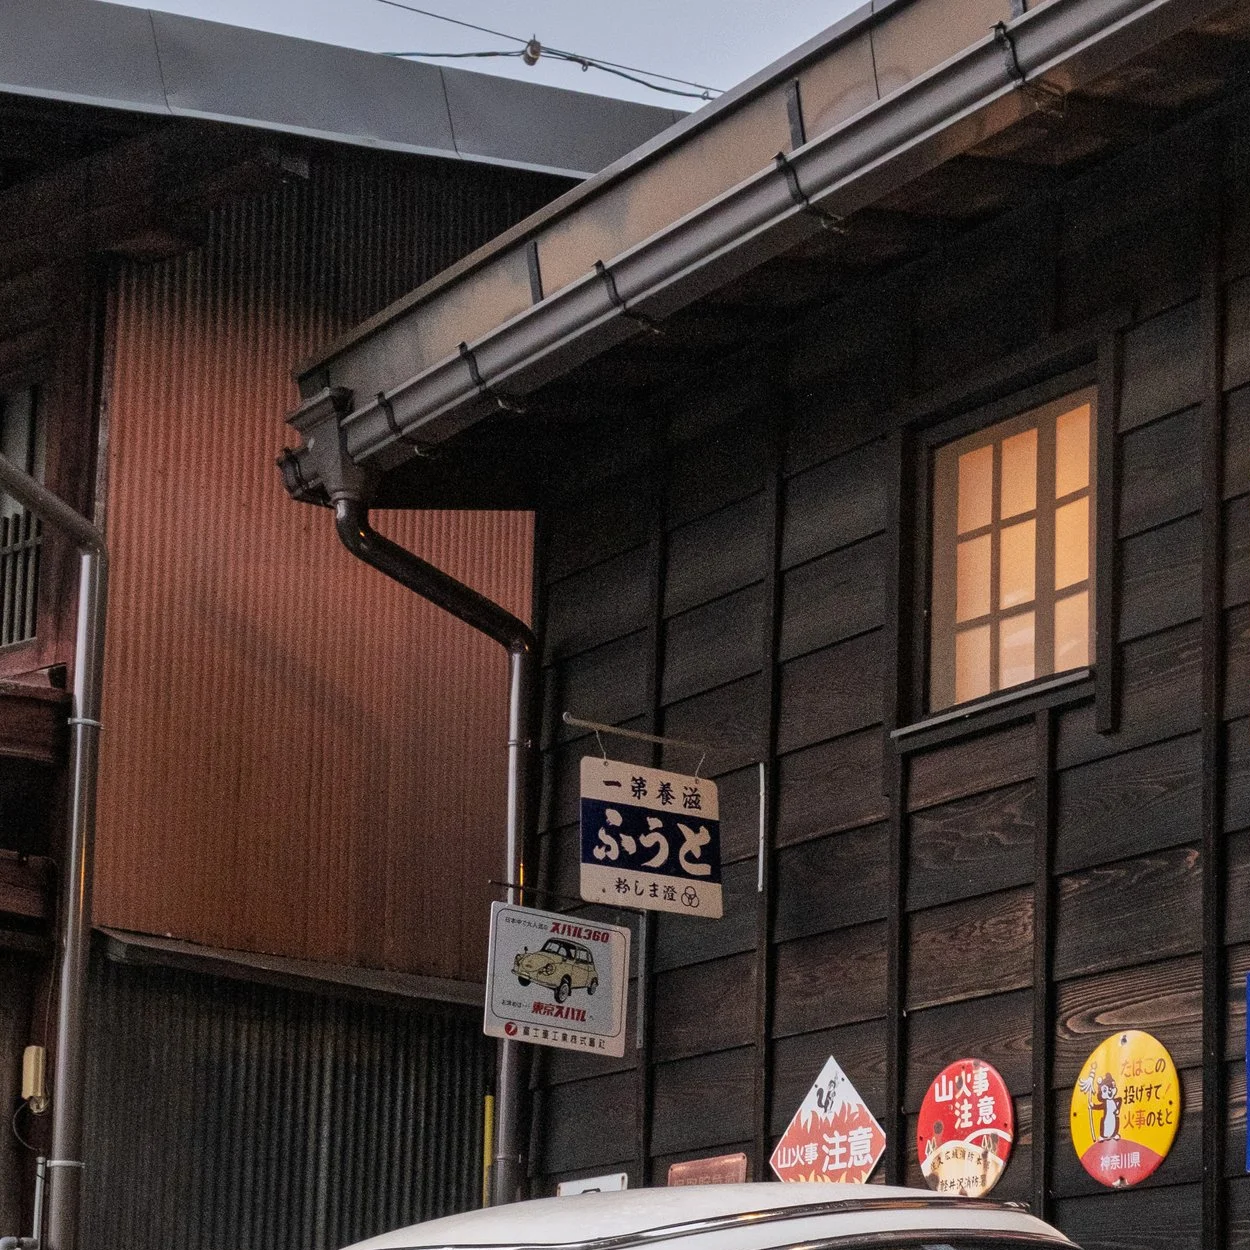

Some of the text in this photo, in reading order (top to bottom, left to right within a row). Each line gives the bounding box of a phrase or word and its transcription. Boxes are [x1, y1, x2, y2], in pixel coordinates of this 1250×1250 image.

[550, 921, 611, 943] スバル360
[531, 1001, 587, 1022] 東京スバル
[1121, 1056, 1166, 1078] たばこの
[934, 1066, 990, 1103] 山火事
[954, 1096, 997, 1130] 注意
[1123, 1108, 1174, 1130] 火事のもと
[1099, 1151, 1141, 1172] 神奈川県
